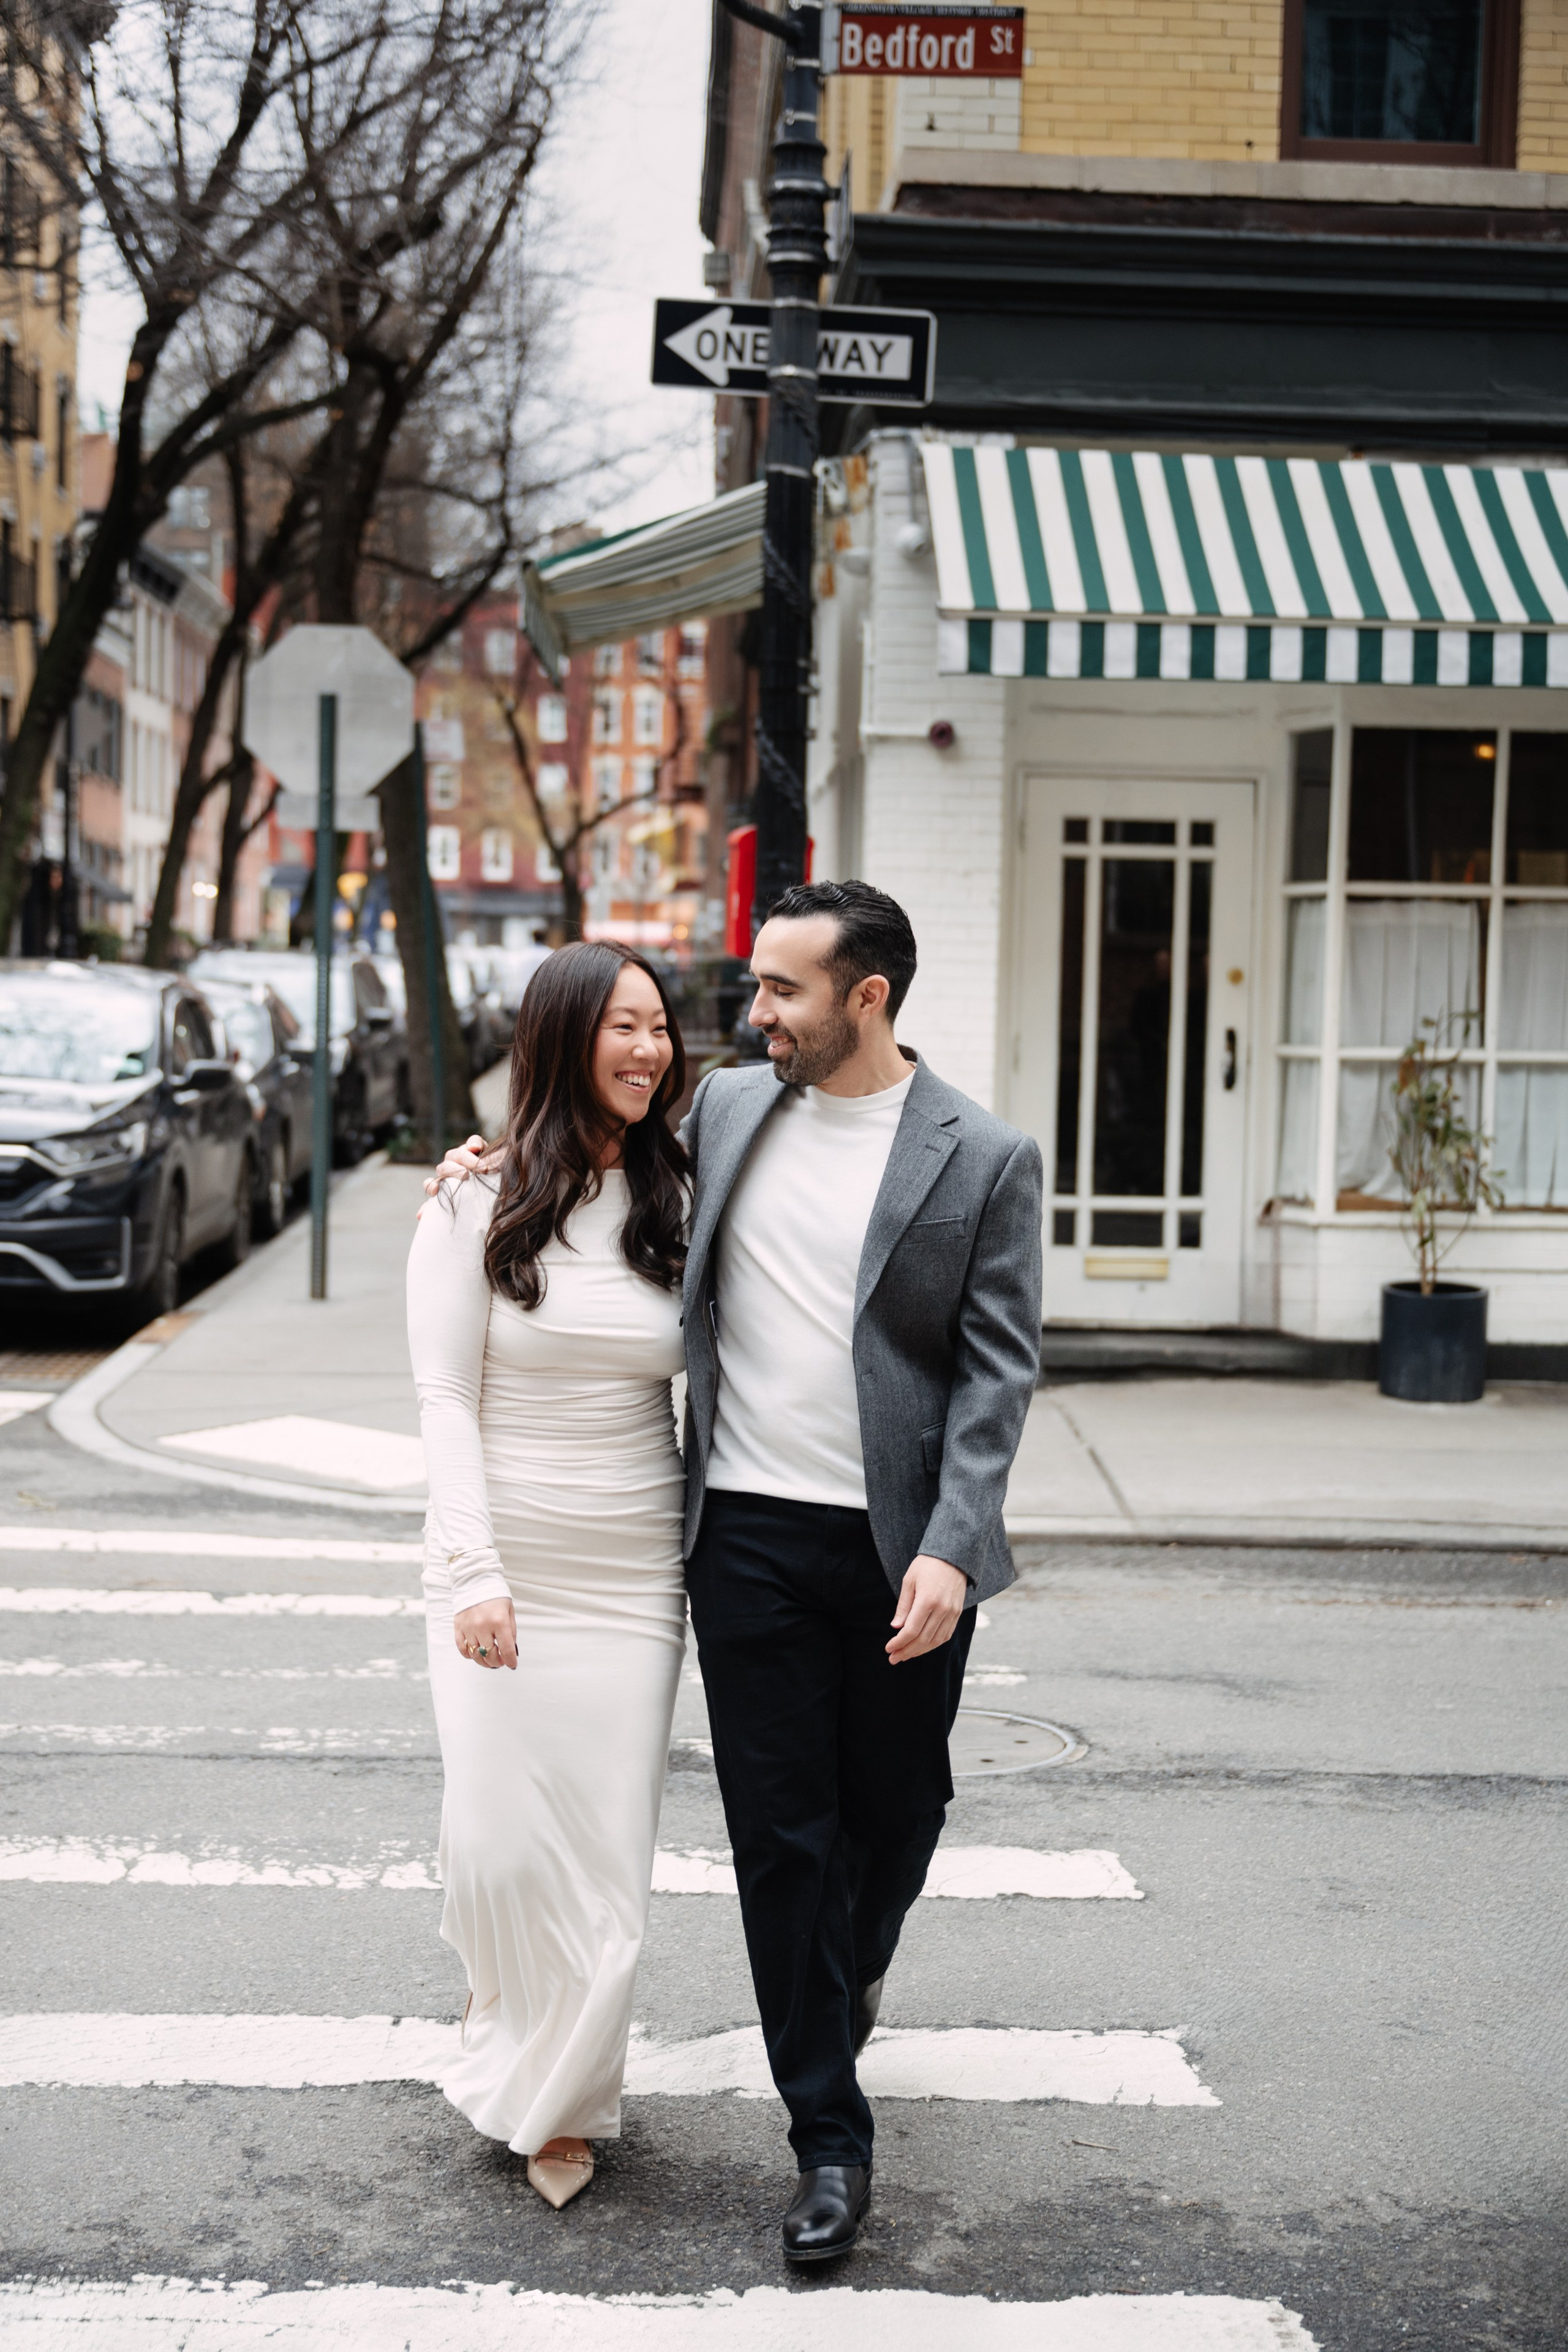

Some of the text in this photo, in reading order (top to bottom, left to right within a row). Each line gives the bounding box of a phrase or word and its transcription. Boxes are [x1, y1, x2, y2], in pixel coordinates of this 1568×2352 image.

[842, 23, 1014, 69] Bedford St
[696, 329, 892, 372] ONE WAY
